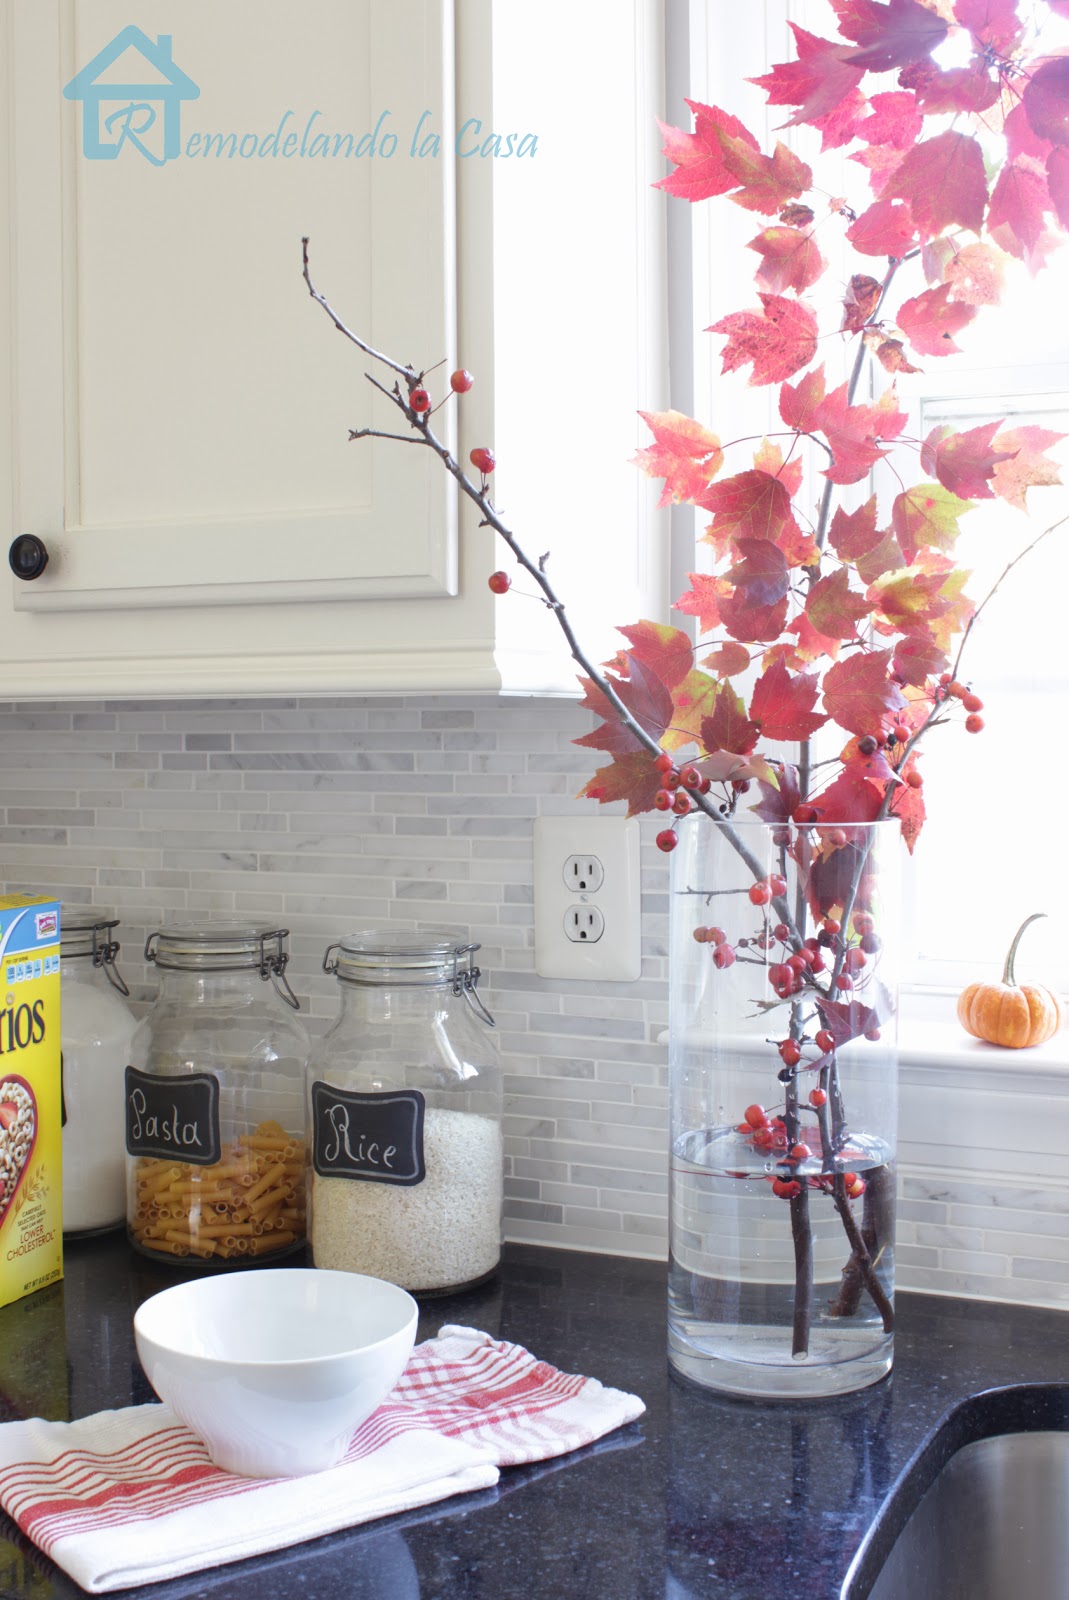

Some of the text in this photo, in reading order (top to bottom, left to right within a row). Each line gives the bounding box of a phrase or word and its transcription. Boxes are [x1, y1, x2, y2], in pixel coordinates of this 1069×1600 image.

[129, 1088, 202, 1146] Pasta
[324, 1104, 397, 1168] Rice
[22, 1204, 42, 1218] CAREFULLY
[17, 1214, 36, 1227] SELECTED
[20, 1224, 44, 1244] LOWER
[23, 1281, 32, 1291] NET
[32, 1278, 39, 1288] WT
